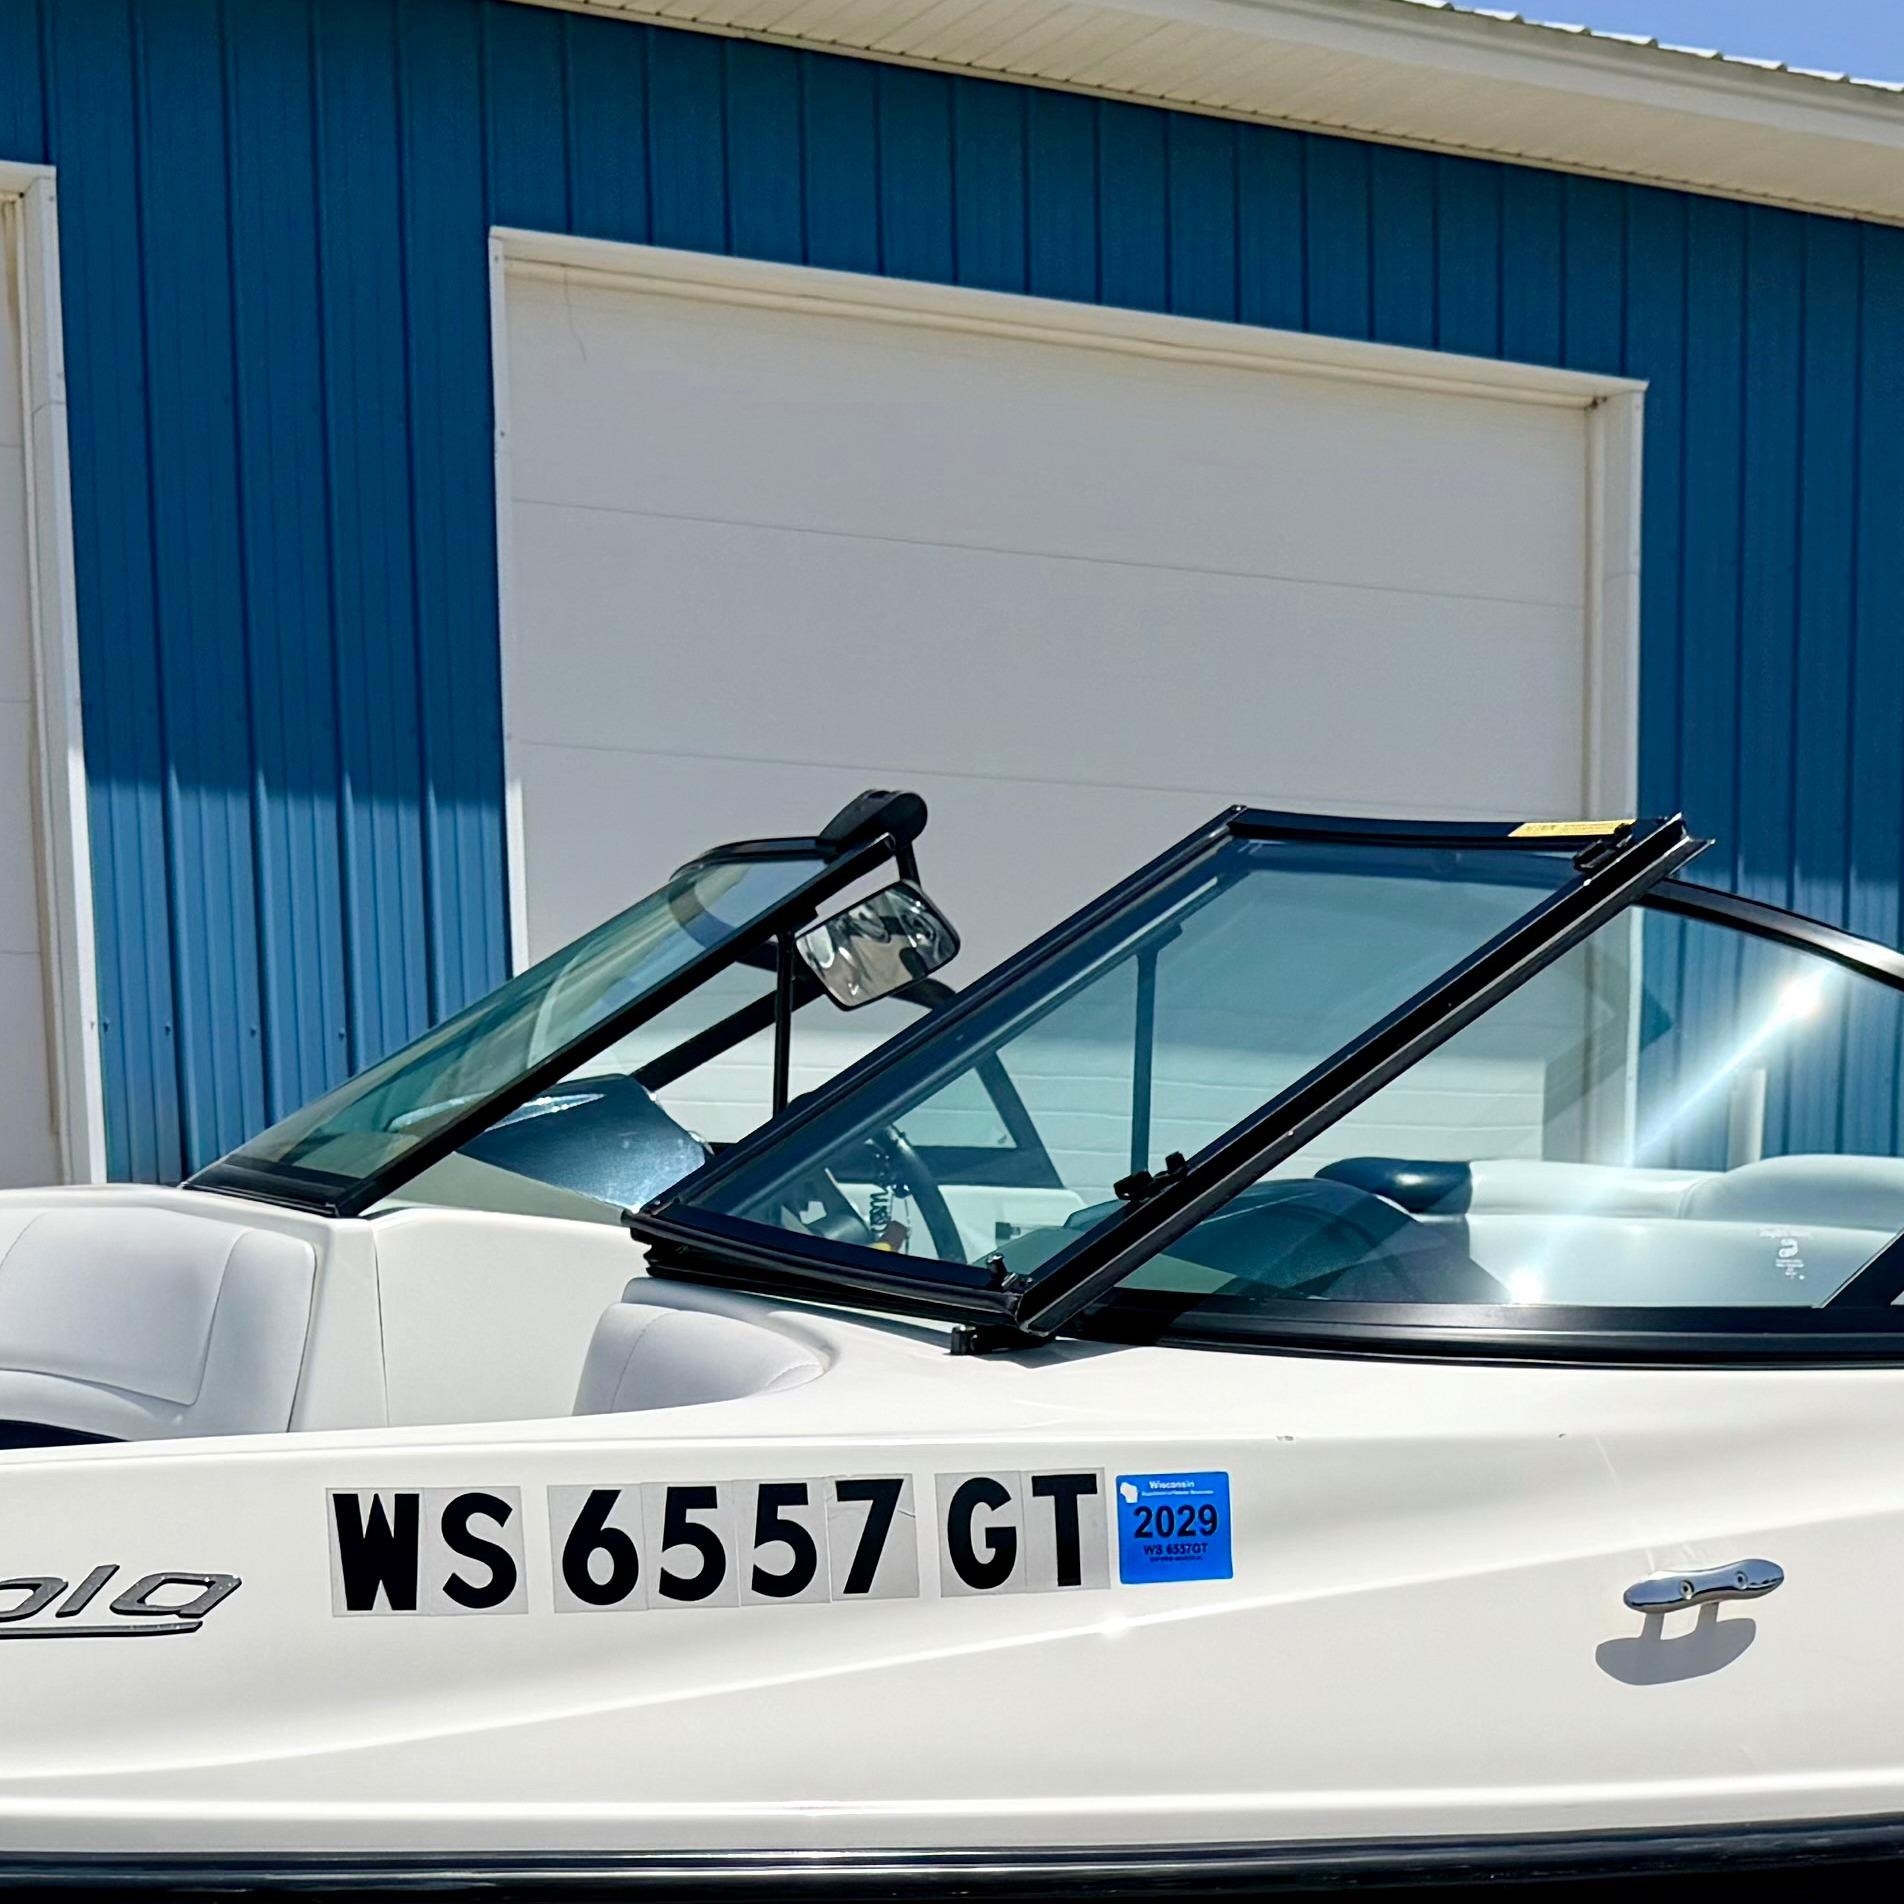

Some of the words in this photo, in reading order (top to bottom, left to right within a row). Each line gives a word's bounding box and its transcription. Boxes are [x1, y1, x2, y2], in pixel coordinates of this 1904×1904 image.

[332, 1491, 518, 1611] WS
[560, 1478, 904, 1605] 6557
[946, 1473, 1099, 1590] GT
[1133, 1503, 1218, 1539] 2029
